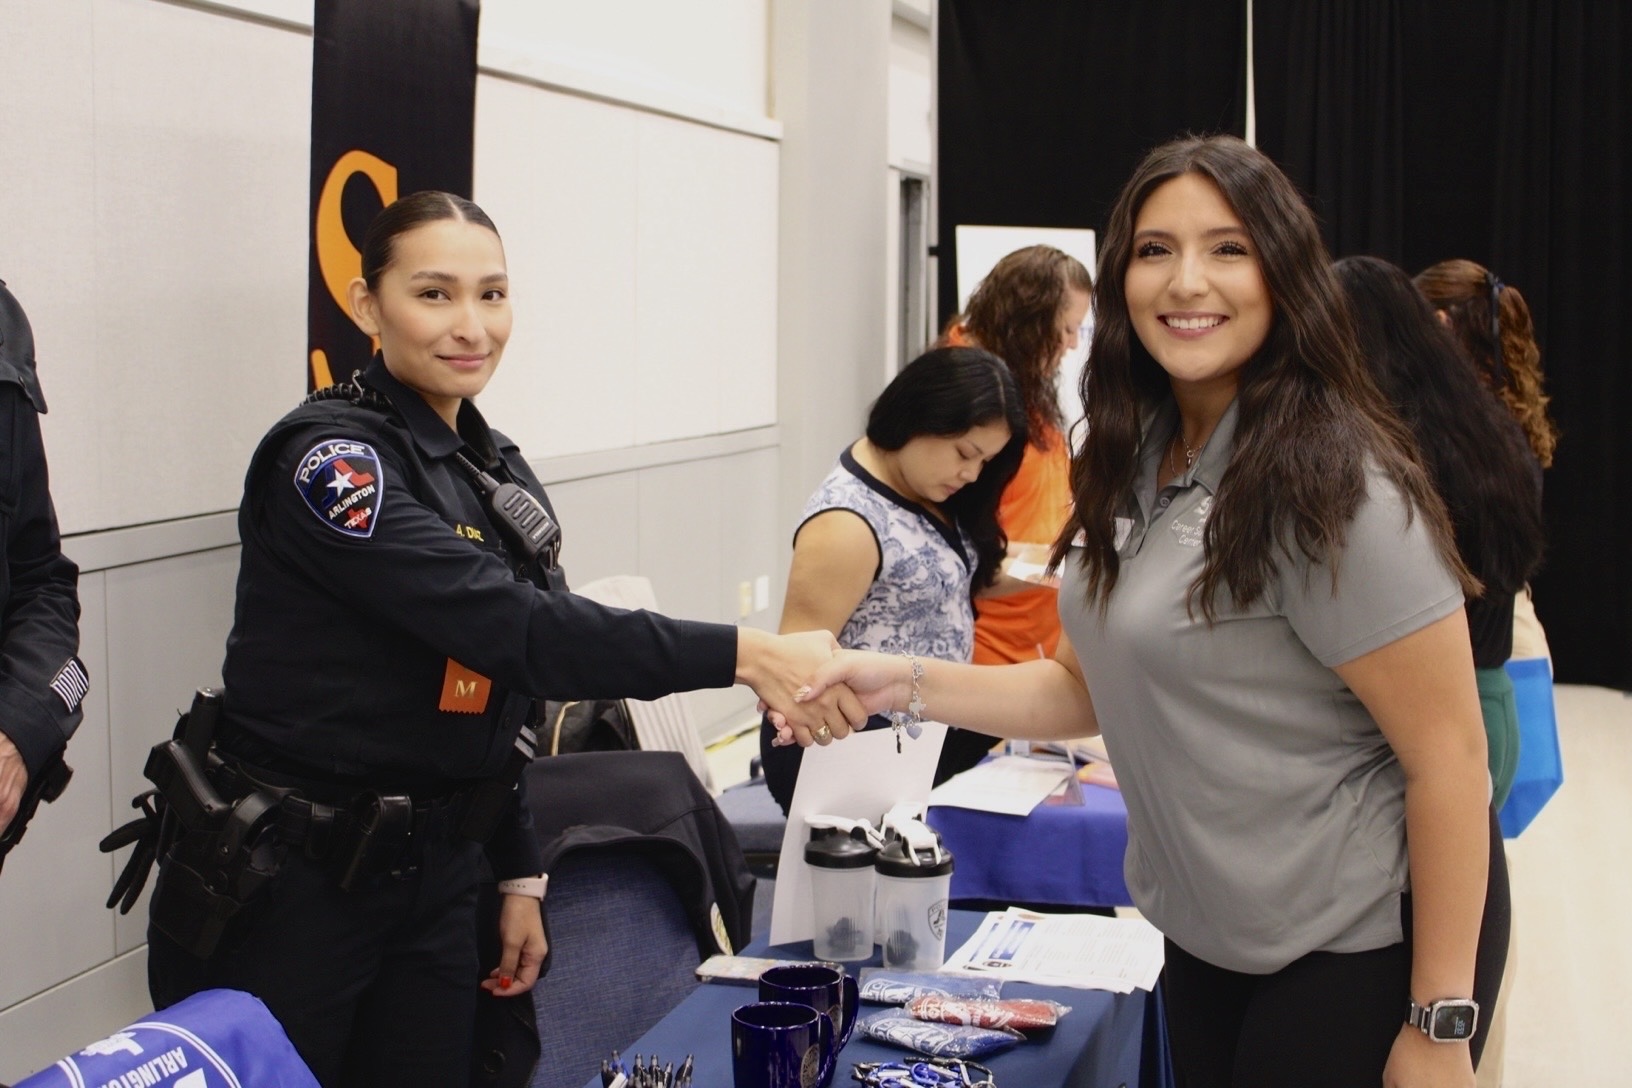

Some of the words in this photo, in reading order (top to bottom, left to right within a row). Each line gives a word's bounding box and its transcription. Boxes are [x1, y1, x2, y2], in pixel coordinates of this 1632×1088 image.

[299, 443, 366, 484] POLICE
[328, 484, 376, 521] ARLINGTON
[344, 507, 372, 530] TEXAS
[454, 679, 479, 699] M
[98, 1046, 188, 1088] ARLINGT
